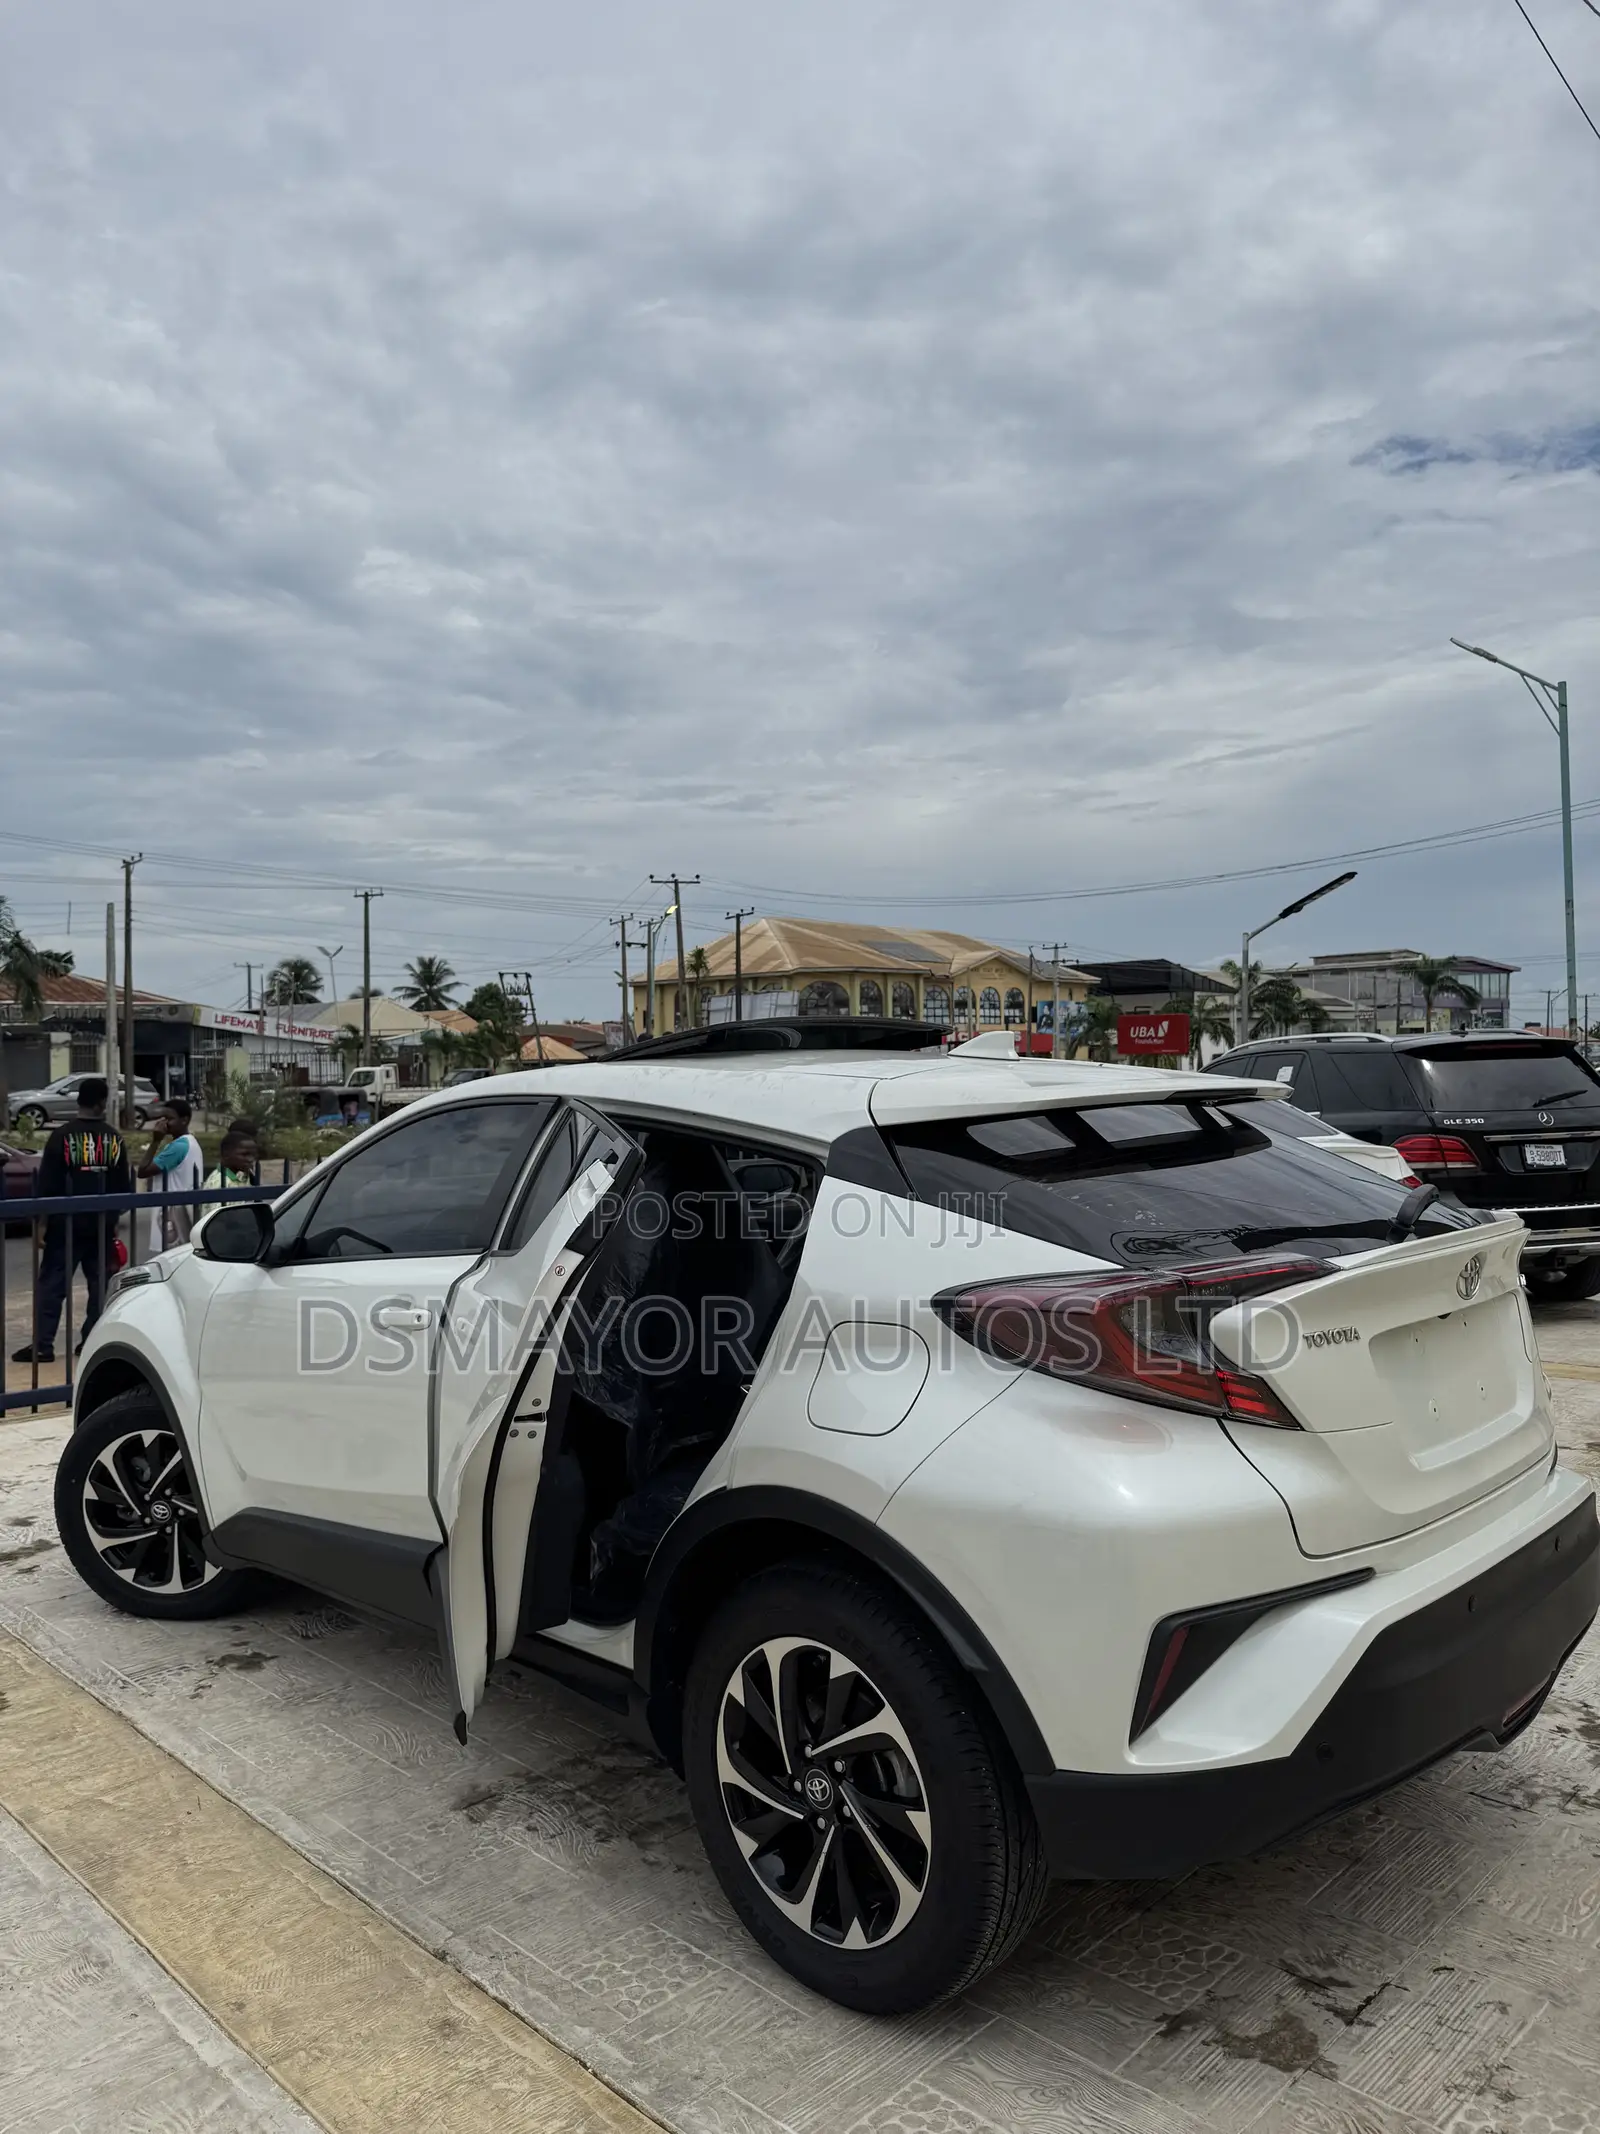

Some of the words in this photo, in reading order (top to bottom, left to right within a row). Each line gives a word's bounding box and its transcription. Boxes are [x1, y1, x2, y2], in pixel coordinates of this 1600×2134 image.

[214, 1013, 266, 1034] LIFEMATE
[276, 1023, 335, 1040] FURNITURE
[1130, 1026, 1156, 1038] UBA
[1303, 1326, 1361, 1349] TOYOTA
